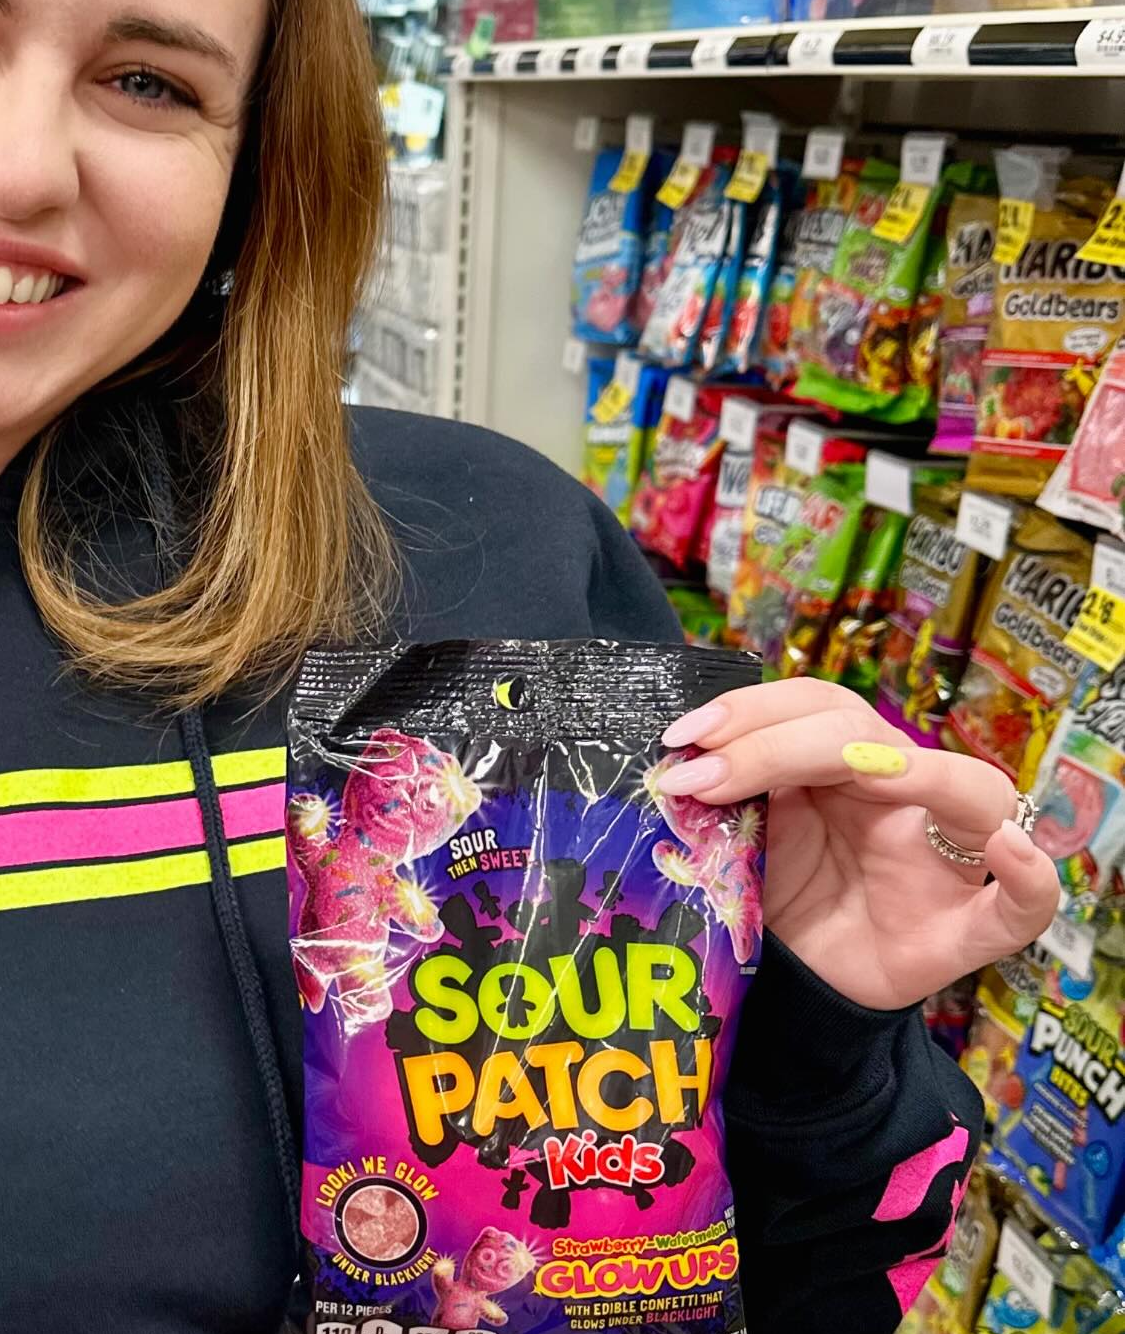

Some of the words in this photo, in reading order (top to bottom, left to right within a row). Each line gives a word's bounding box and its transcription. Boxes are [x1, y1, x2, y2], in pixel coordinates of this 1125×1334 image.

[1004, 289, 1121, 323] Goldbears
[447, 856, 478, 880] THEN
[479, 847, 533, 871] SWEET
[449, 829, 498, 860] SOUR
[413, 941, 700, 1047] SOUR
[1064, 1002, 1119, 1067] SOUR
[1031, 1010, 1125, 1121] PUNCH
[403, 1037, 713, 1147] PATCH
[541, 1129, 666, 1190] Kids
[315, 1161, 358, 1207] LOOK!
[361, 1156, 386, 1174] WE
[394, 1162, 439, 1201] GLOW
[552, 1220, 727, 1256] Strawberry-Watermelon
[332, 1251, 370, 1284] UNDER
[375, 1246, 438, 1286] BLACKLIGHT
[535, 1254, 665, 1299] GLOW
[665, 1237, 740, 1290] UPS
[315, 1300, 337, 1315] PER
[340, 1303, 353, 1316] 12
[356, 1304, 392, 1316] PIECES
[564, 1303, 591, 1316] WITH
[593, 1300, 637, 1316] EDIBLE
[639, 1295, 698, 1312] CONFETTI
[700, 1290, 724, 1304] THAT
[570, 1317, 606, 1329] GLOWS
[608, 1315, 643, 1327] UNDER
[645, 1305, 719, 1324] BLACKLIGHT
